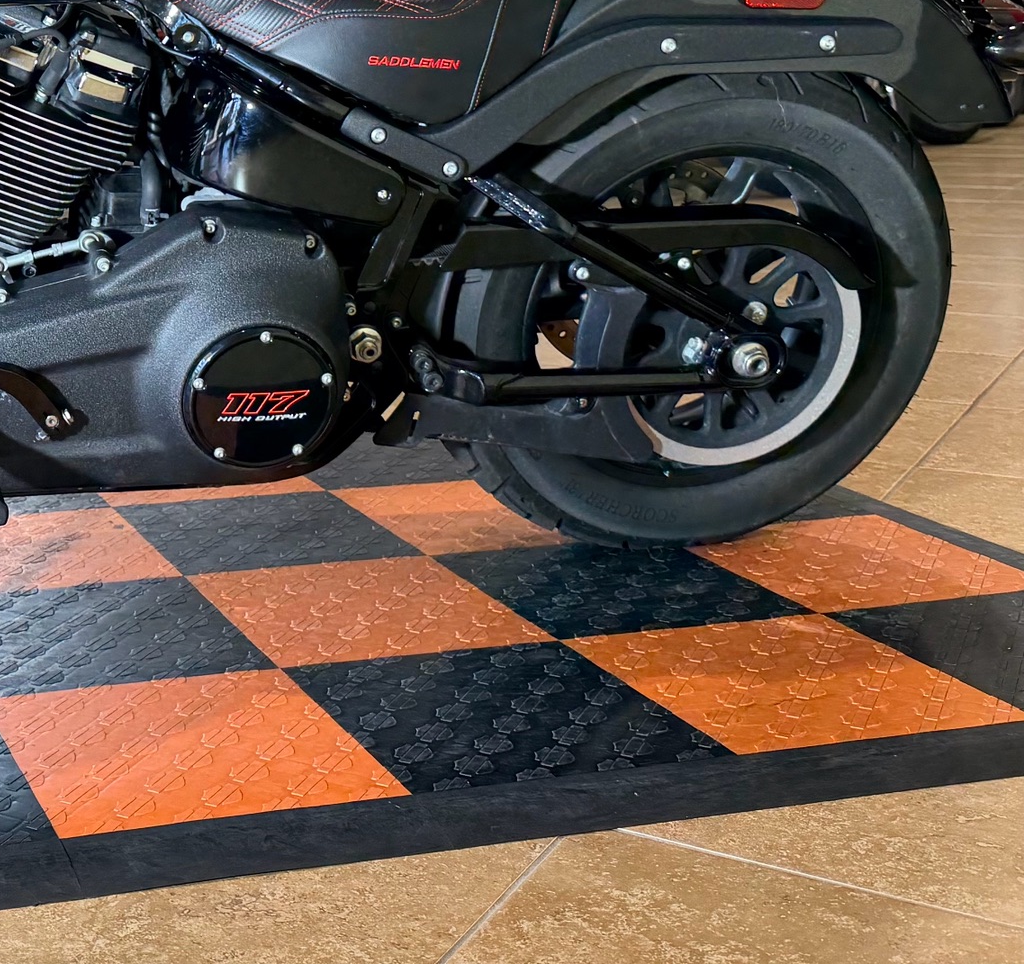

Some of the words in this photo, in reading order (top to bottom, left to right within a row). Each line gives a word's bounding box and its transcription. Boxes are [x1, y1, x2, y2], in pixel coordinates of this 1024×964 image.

[367, 55, 461, 70] SADDLEMEN
[222, 389, 310, 415] 117
[217, 415, 252, 423] HIGH
[255, 412, 307, 422] OUTPUT
[585, 490, 679, 525] SCORCHER
